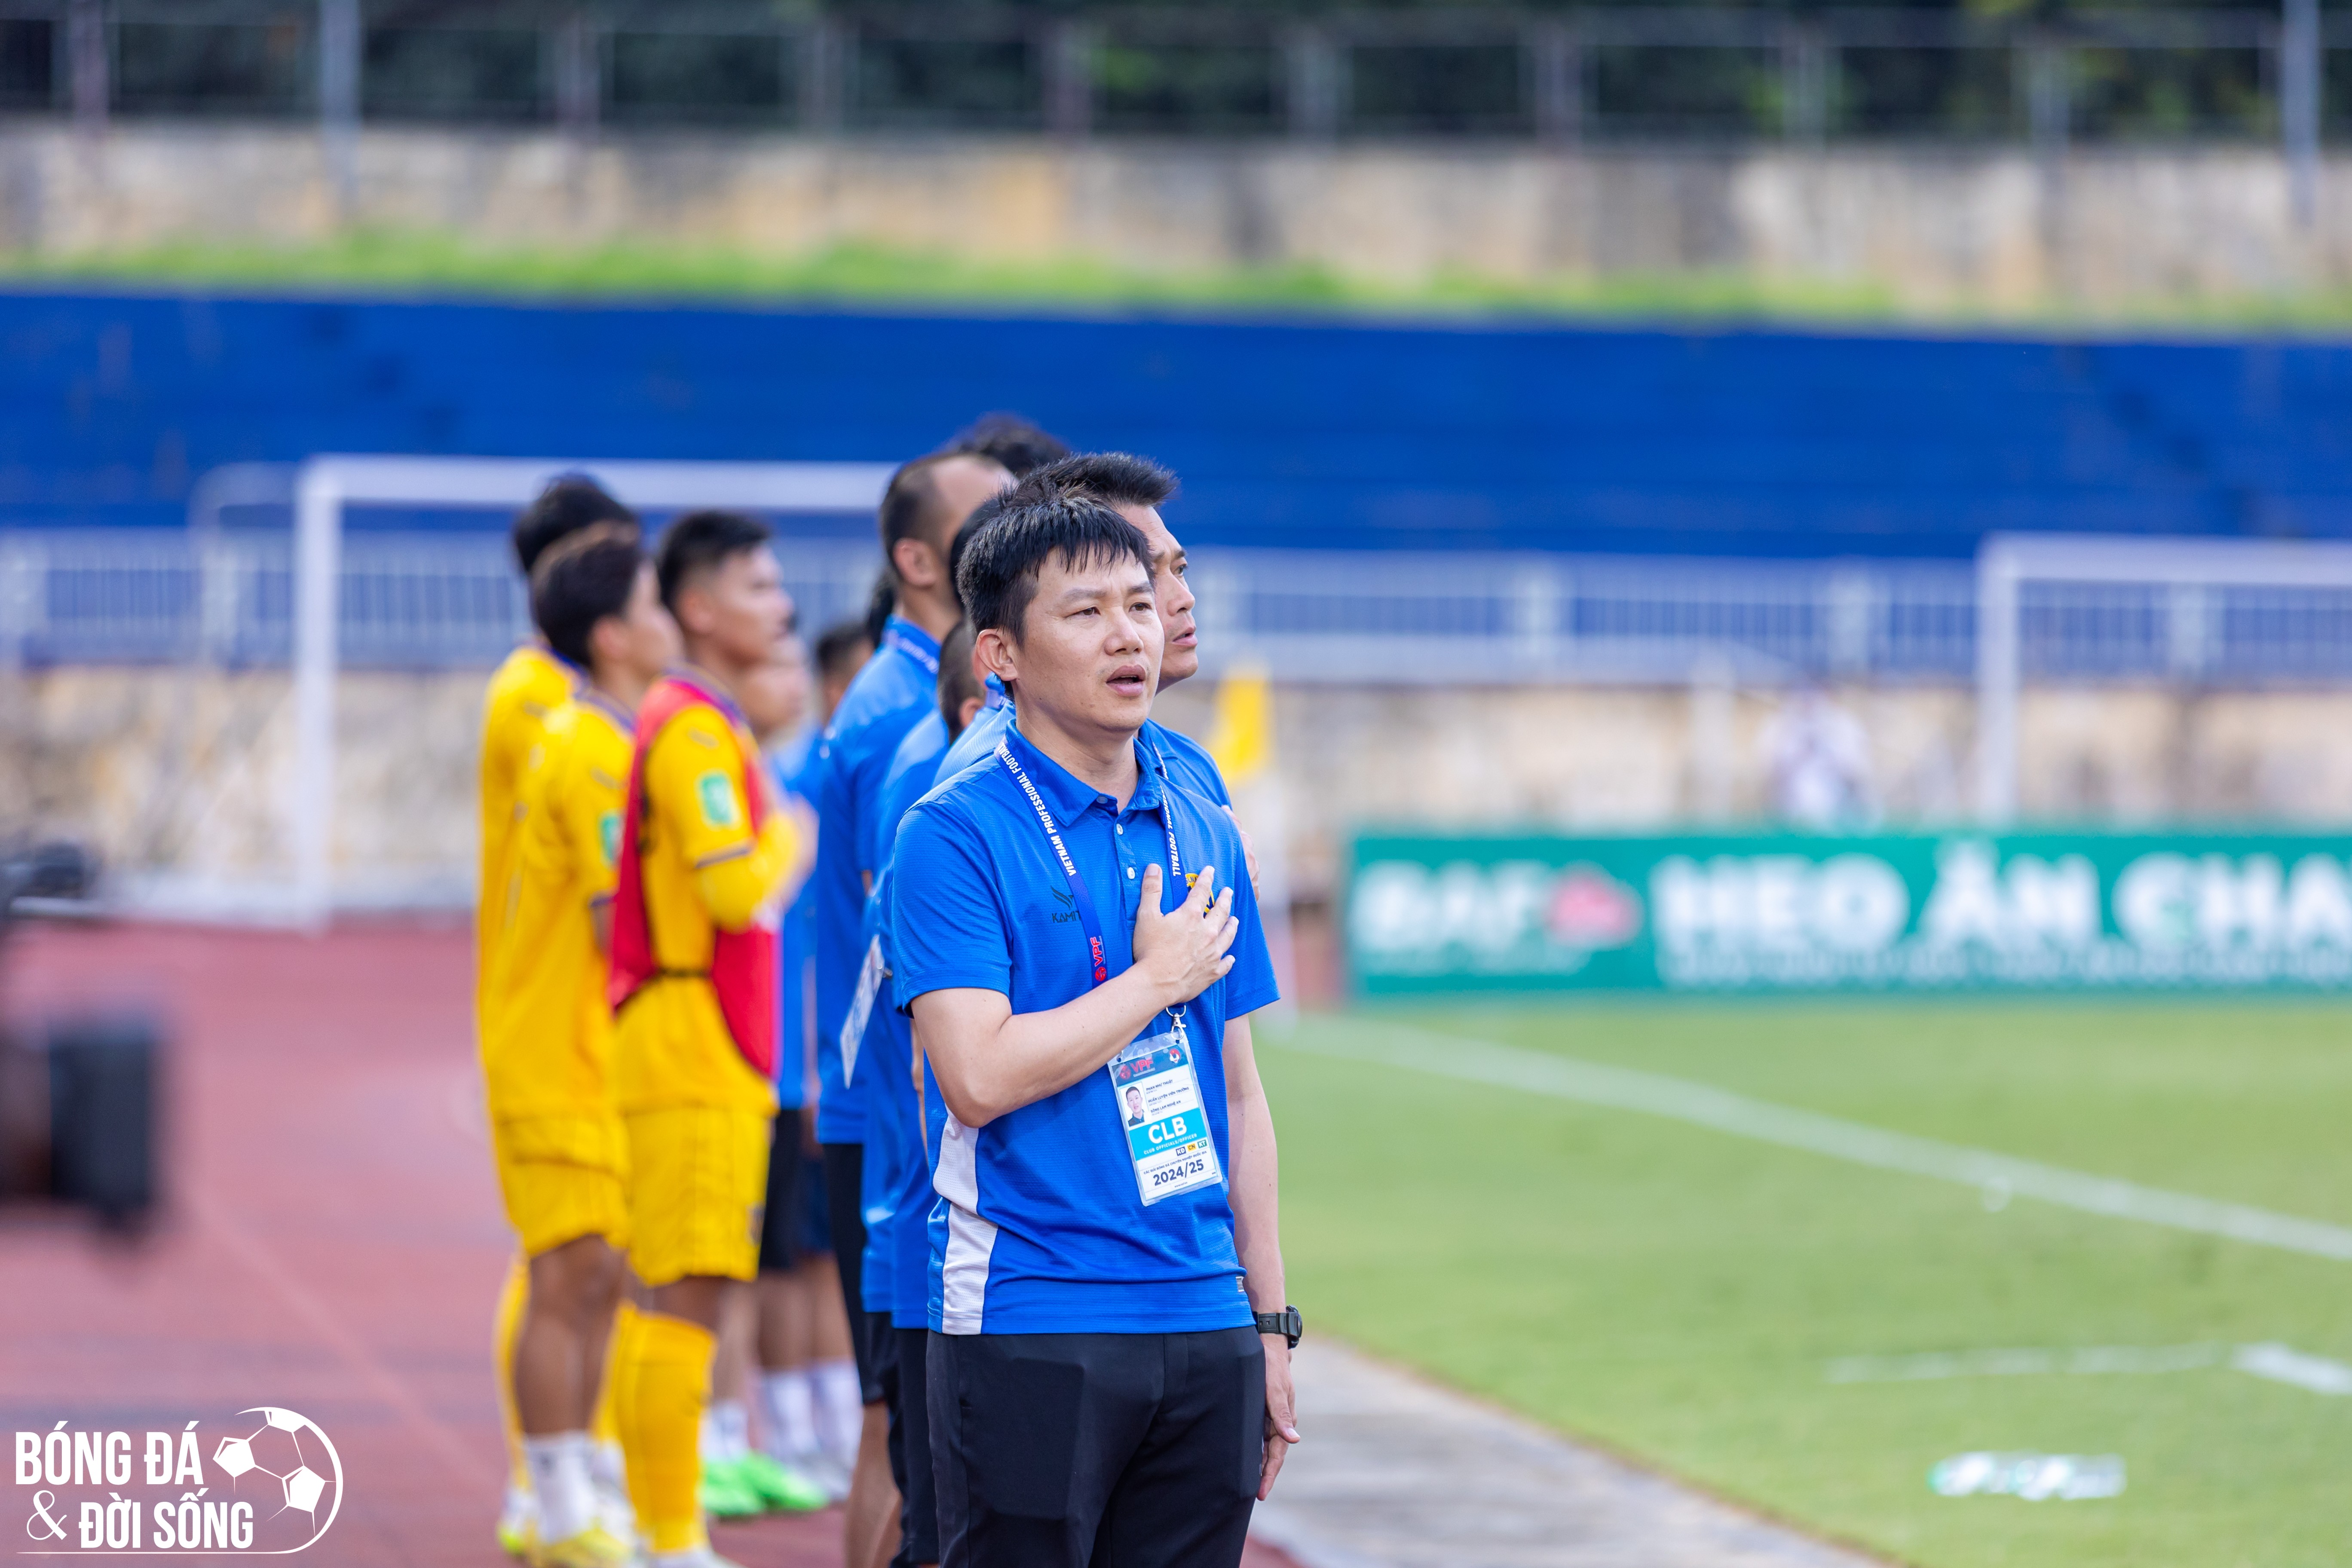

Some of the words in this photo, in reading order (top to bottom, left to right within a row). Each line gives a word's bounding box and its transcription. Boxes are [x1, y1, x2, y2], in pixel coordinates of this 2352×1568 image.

[998, 742, 1022, 774] FOOTBALL
[1017, 772, 1057, 834] PROFESSIONAL
[1050, 835, 1077, 876] VIETNAM
[1167, 832, 1181, 876] FOOTBALL
[1052, 910, 1081, 923] KAMIT
[1090, 937, 1103, 967] VPF
[1130, 1057, 1153, 1073] VPF
[1148, 1116, 1187, 1144] CLB
[1156, 1133, 1197, 1150] OFFICIALS/OFFICER
[1153, 1159, 1204, 1186] 2024/25
